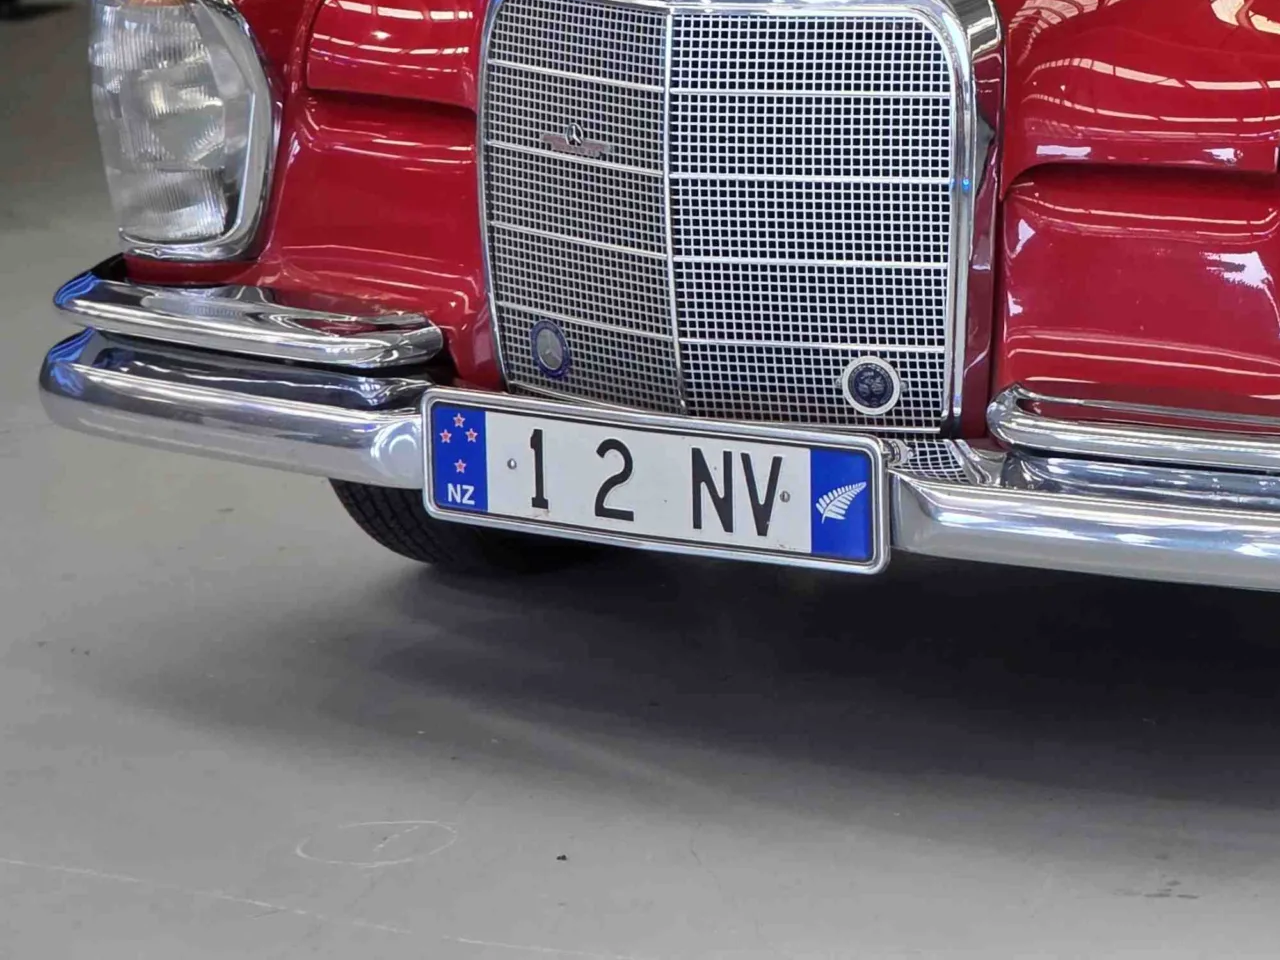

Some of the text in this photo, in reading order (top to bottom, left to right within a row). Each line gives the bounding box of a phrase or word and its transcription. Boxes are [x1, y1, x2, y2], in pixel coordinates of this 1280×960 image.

[446, 482, 476, 505] NZ
[594, 438, 635, 521] 2
[691, 447, 783, 537] NV
